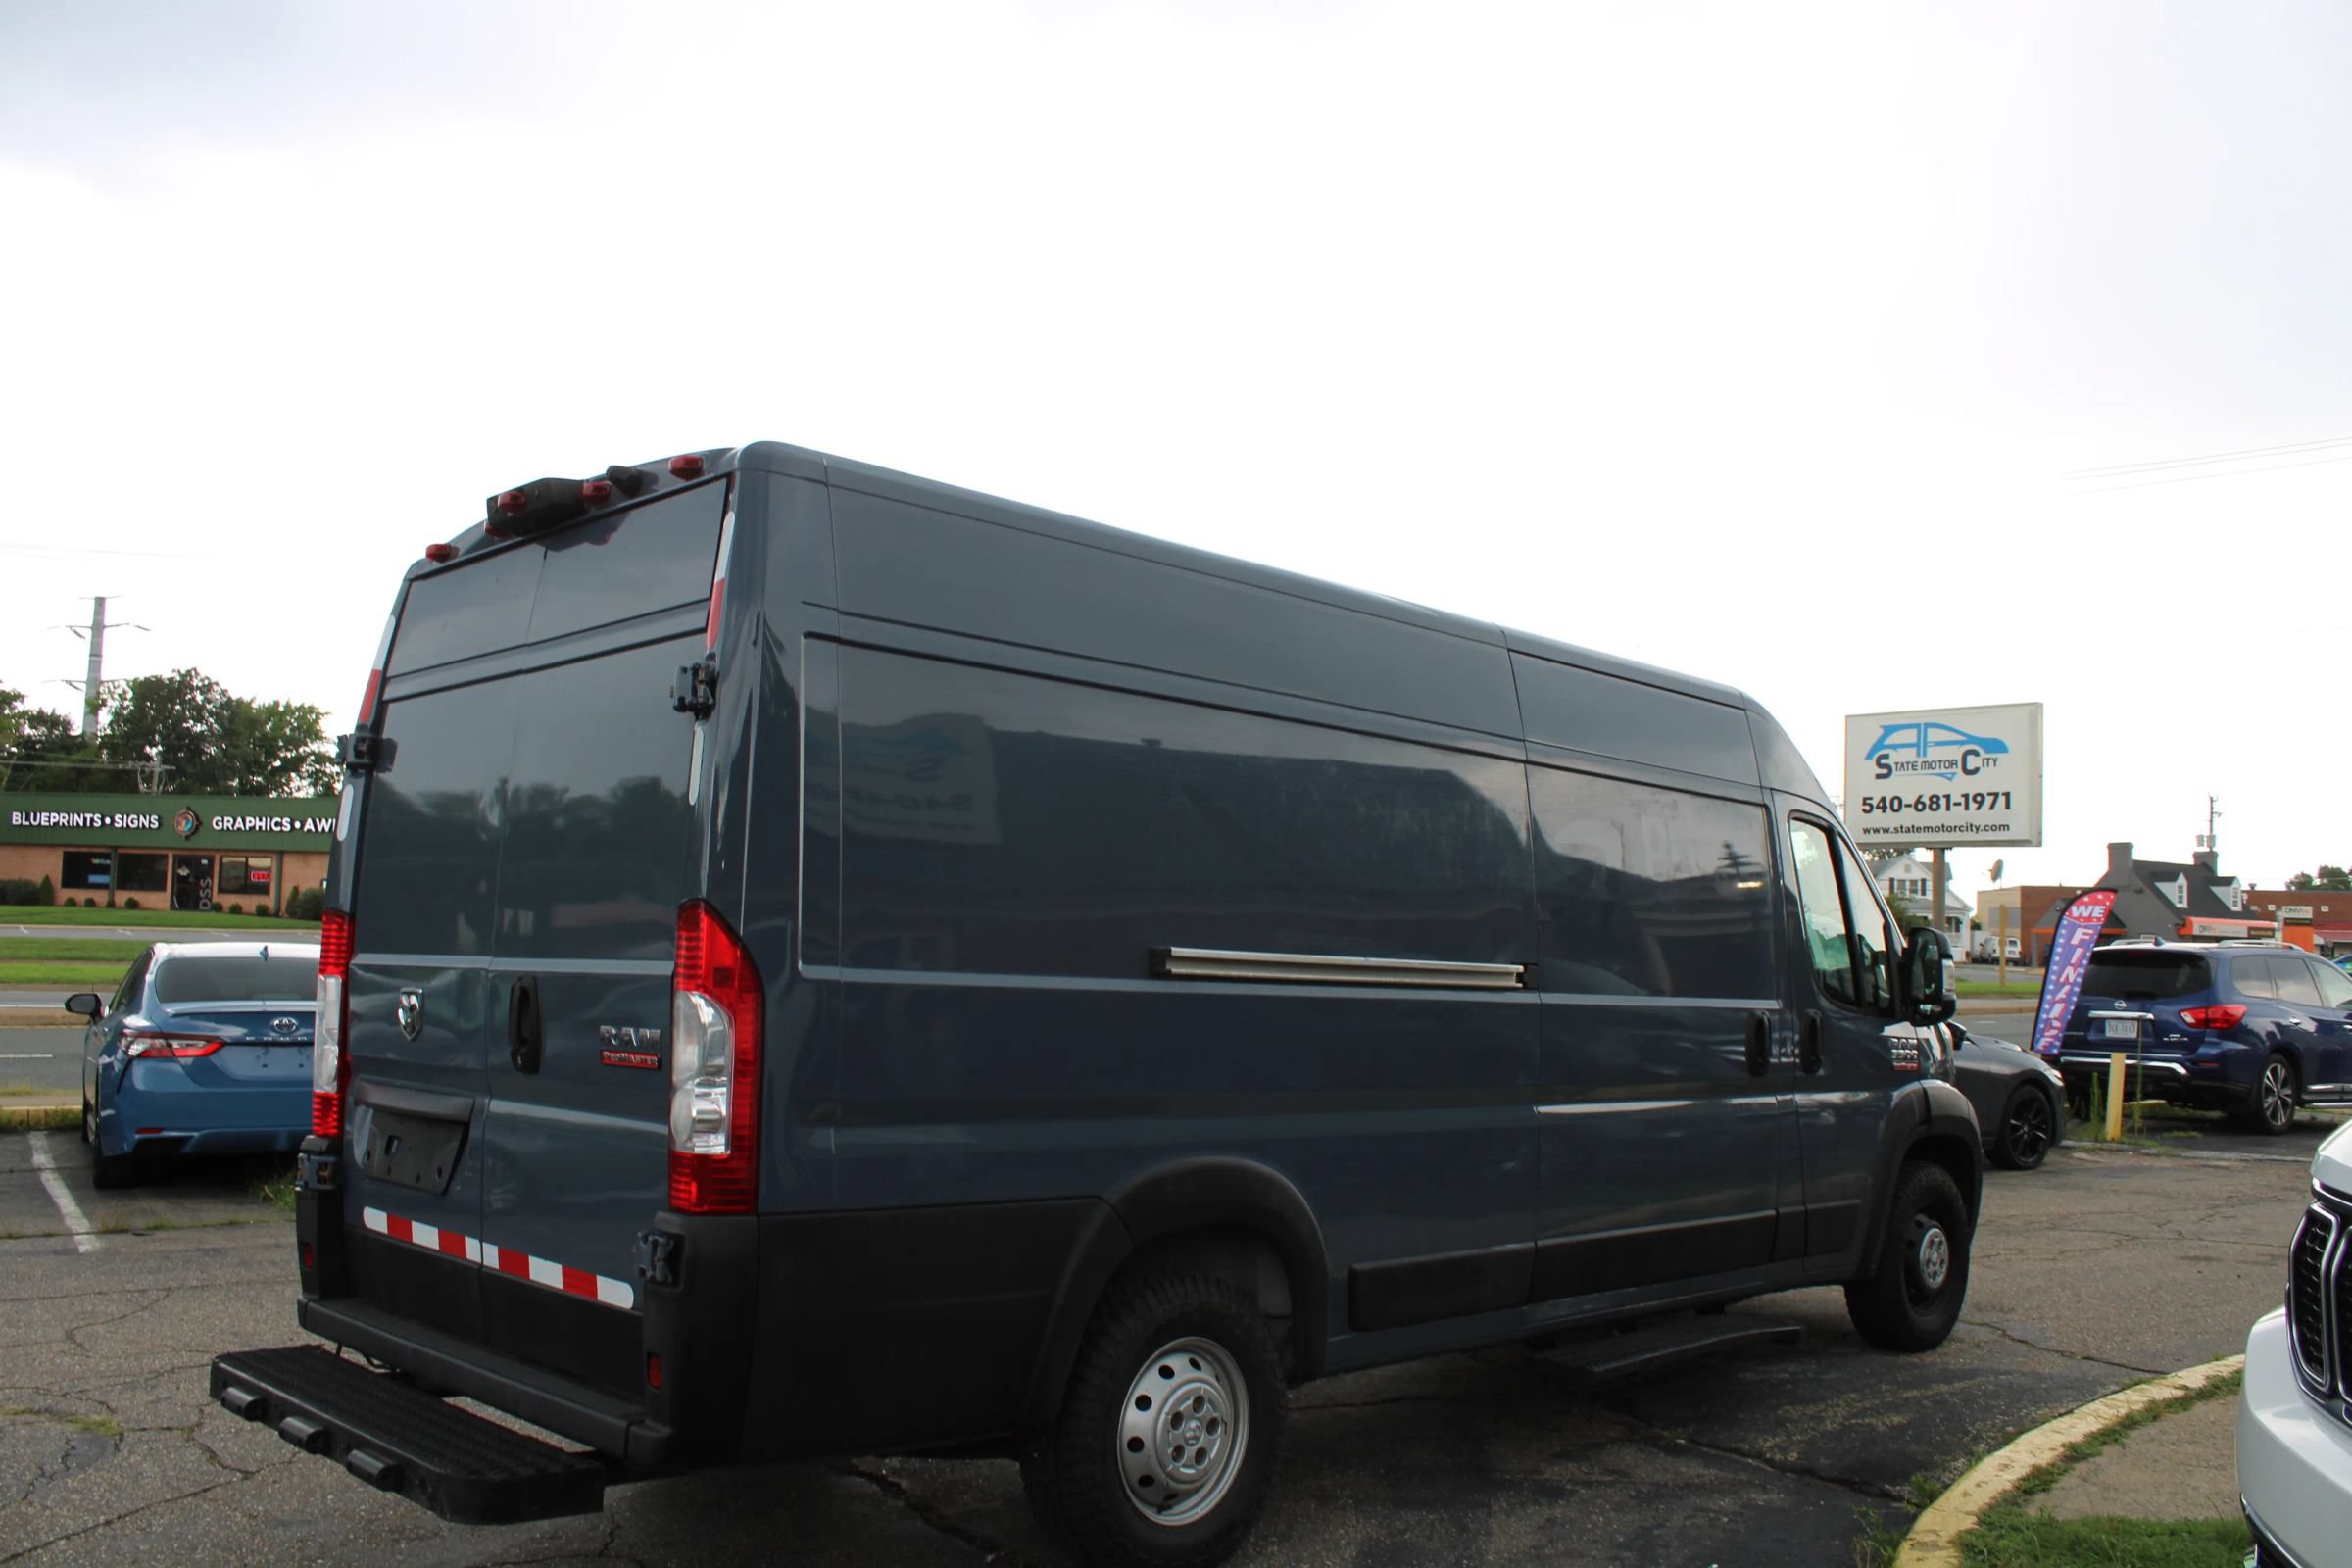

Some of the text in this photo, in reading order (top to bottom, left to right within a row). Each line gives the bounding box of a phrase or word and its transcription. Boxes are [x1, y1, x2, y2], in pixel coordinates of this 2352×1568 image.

[1920, 759, 1958, 771] MOTOR
[1861, 791, 2012, 814] 540-681-1971
[11, 811, 159, 829] BLUEPRINTS SIGNS
[212, 815, 336, 833] GRAPHICS AW
[1862, 821, 2010, 835] www.statemotorcity.com
[199, 877, 212, 910] DSS
[2070, 905, 2106, 918] WE
[600, 1025, 661, 1049] RAM
